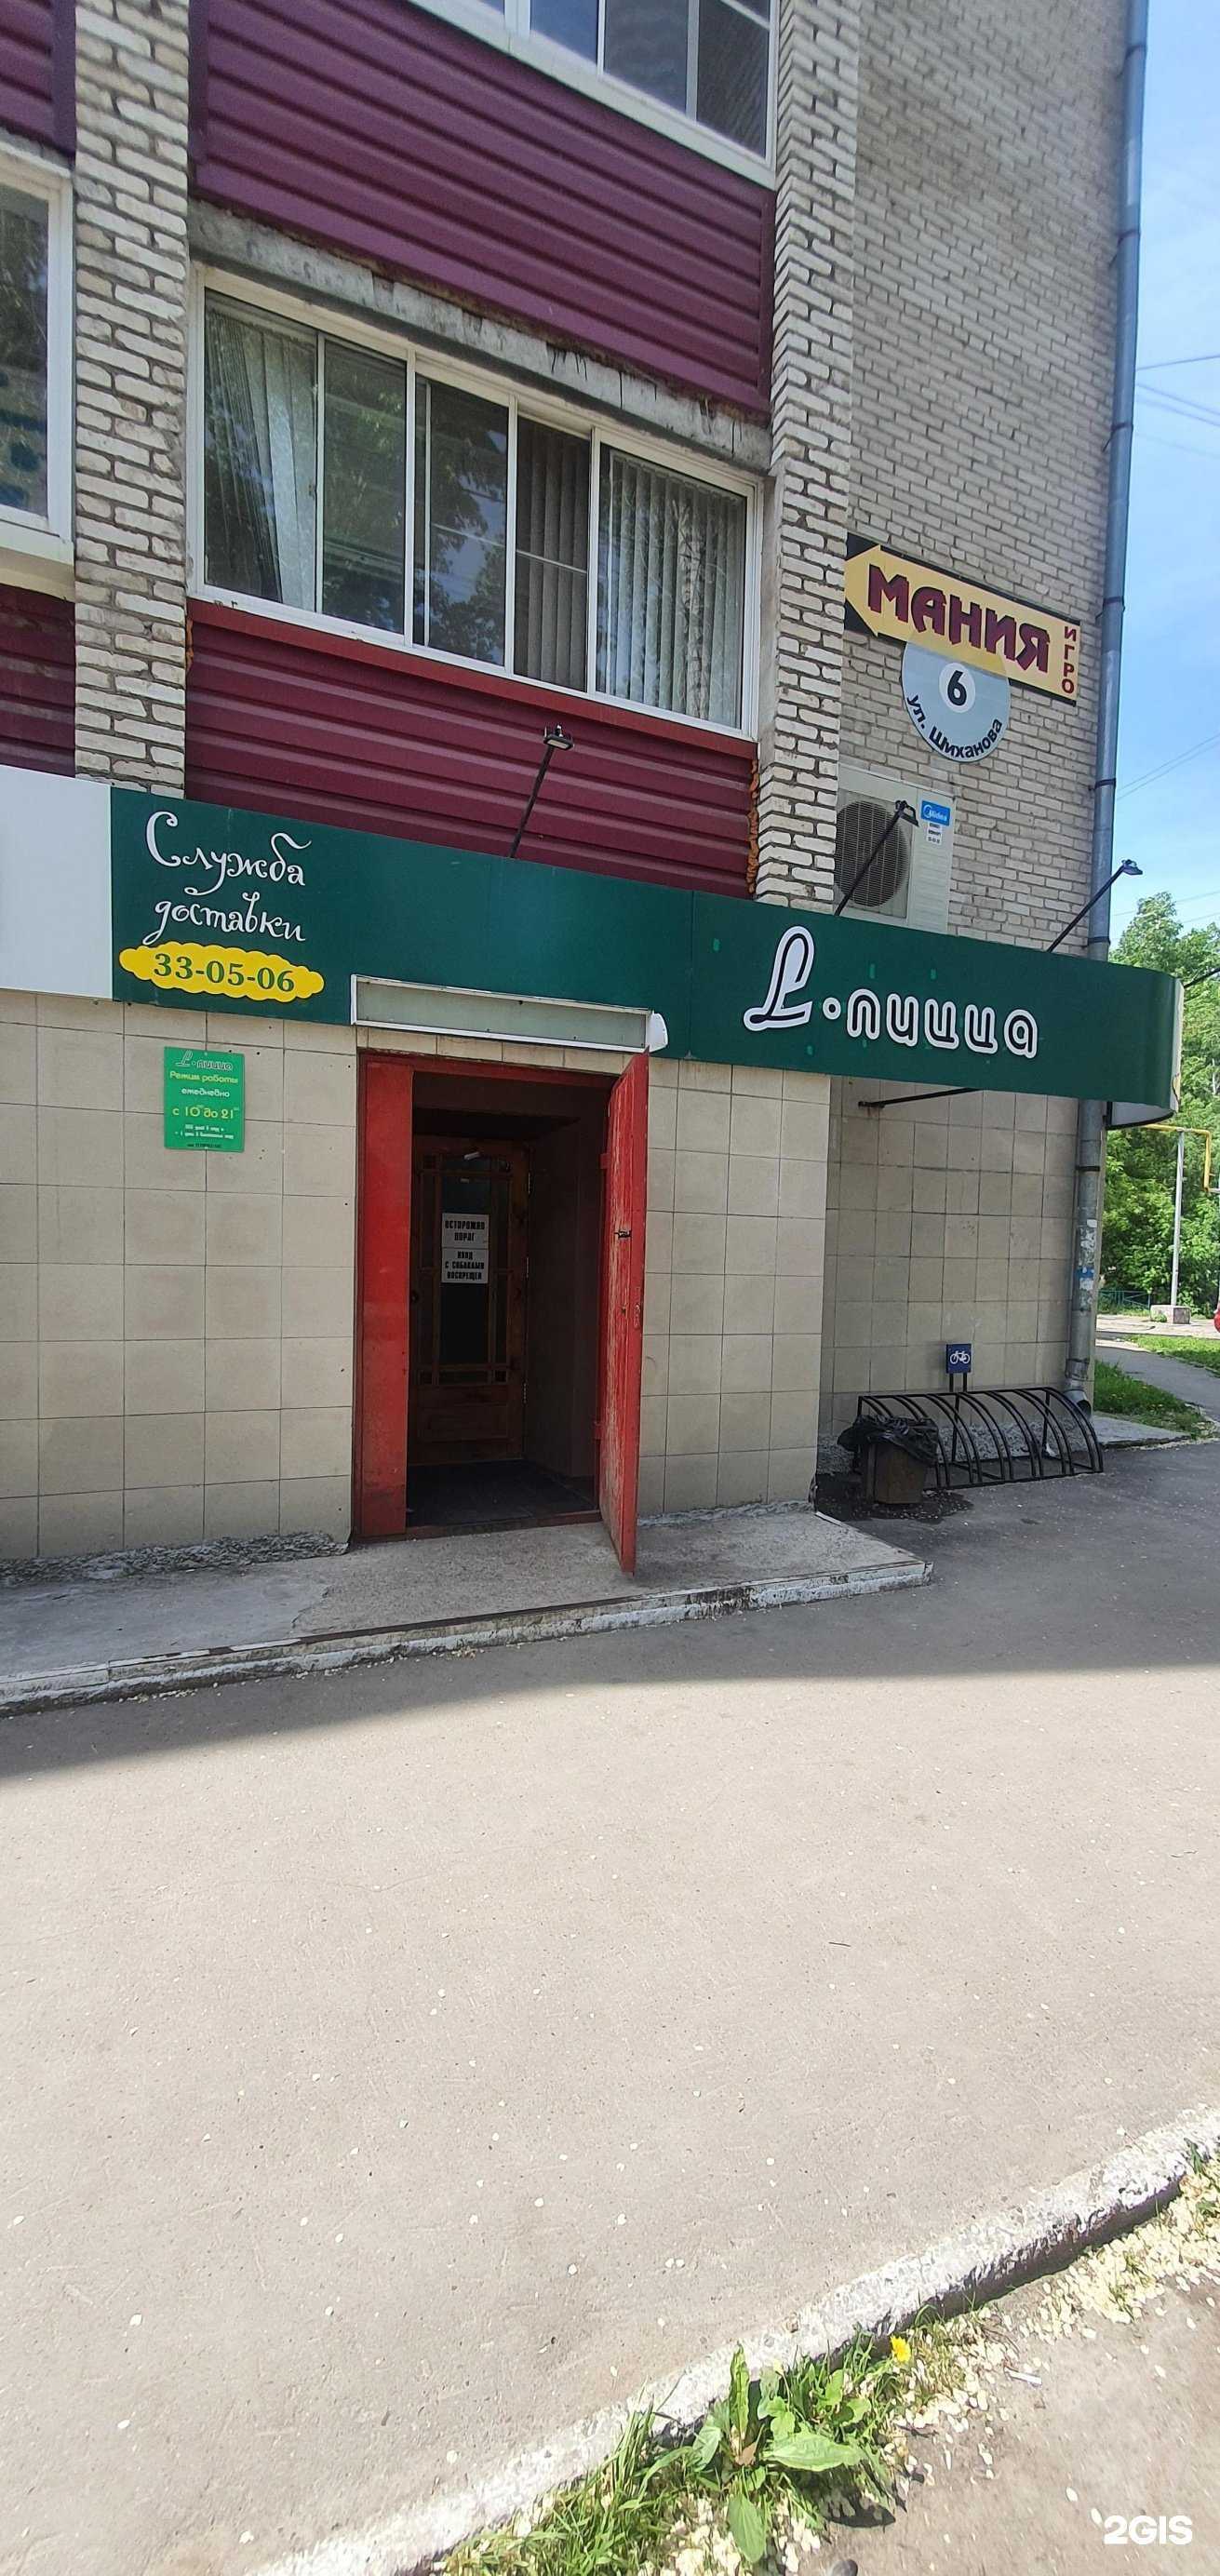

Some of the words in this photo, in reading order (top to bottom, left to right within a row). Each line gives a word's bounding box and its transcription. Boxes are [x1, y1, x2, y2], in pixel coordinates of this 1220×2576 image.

[867, 564, 1051, 673] МАНИЯ
[947, 670, 967, 705] 6
[1062, 625, 1078, 695] ИГРО
[906, 695, 927, 731] ул.
[929, 718, 1003, 759] Шиханова
[146, 811, 312, 896] Служба
[142, 891, 306, 946] доставки
[153, 952, 295, 993] 33-05-06
